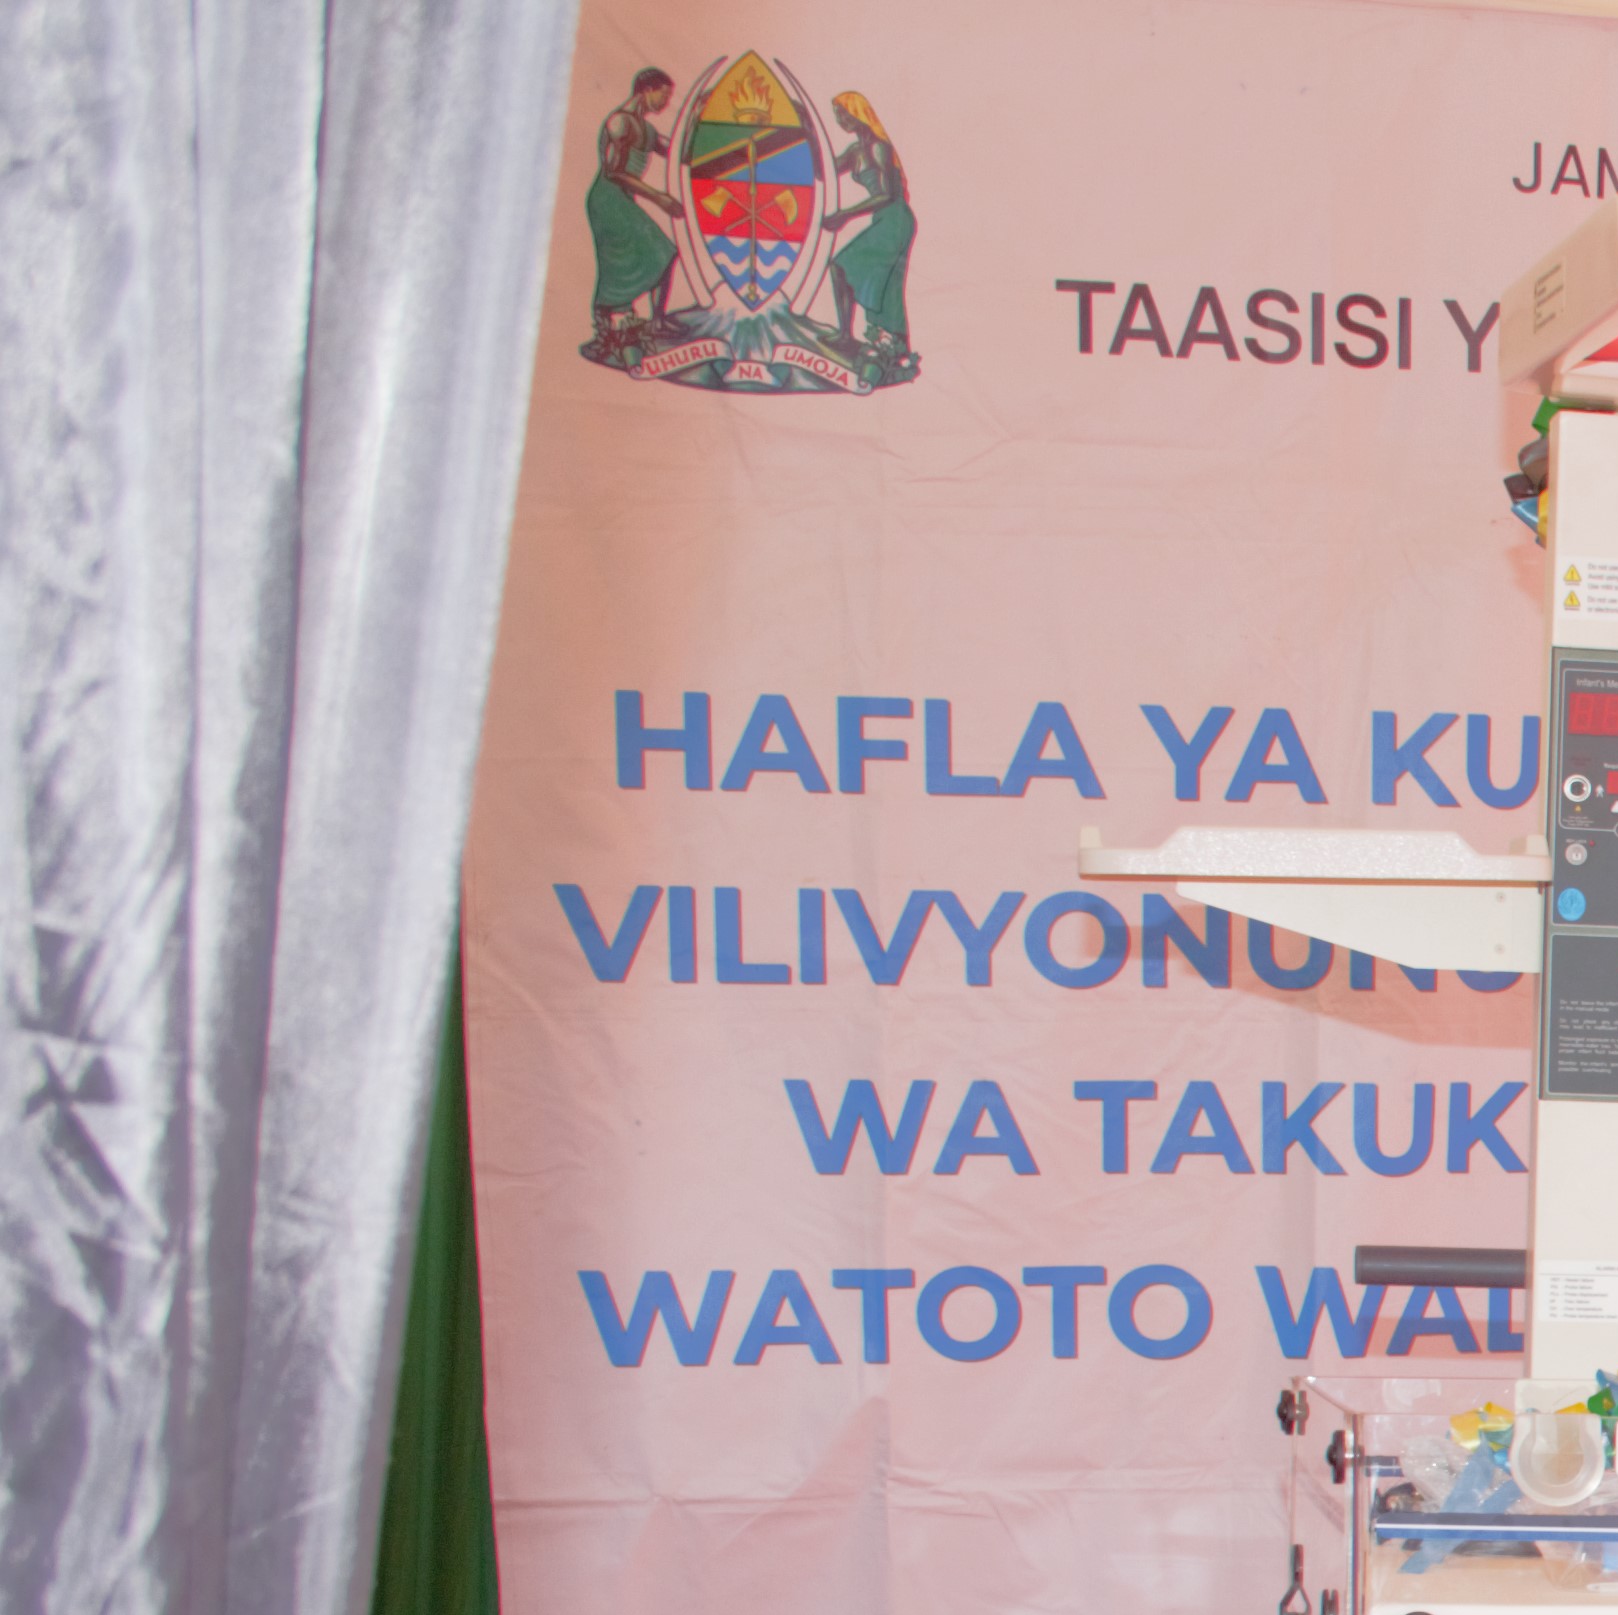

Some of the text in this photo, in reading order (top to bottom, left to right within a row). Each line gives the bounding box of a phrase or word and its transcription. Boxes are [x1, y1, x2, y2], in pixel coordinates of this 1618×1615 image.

[645, 342, 849, 387] UHURU NA UMOJA
[1055, 279, 1413, 372] TAASISI
[1443, 299, 1500, 373] Y
[615, 691, 1104, 799] HAFLA
[1140, 704, 1327, 804] YA
[783, 1079, 1038, 1176] WA
[578, 1264, 1212, 1367] WATOTO
